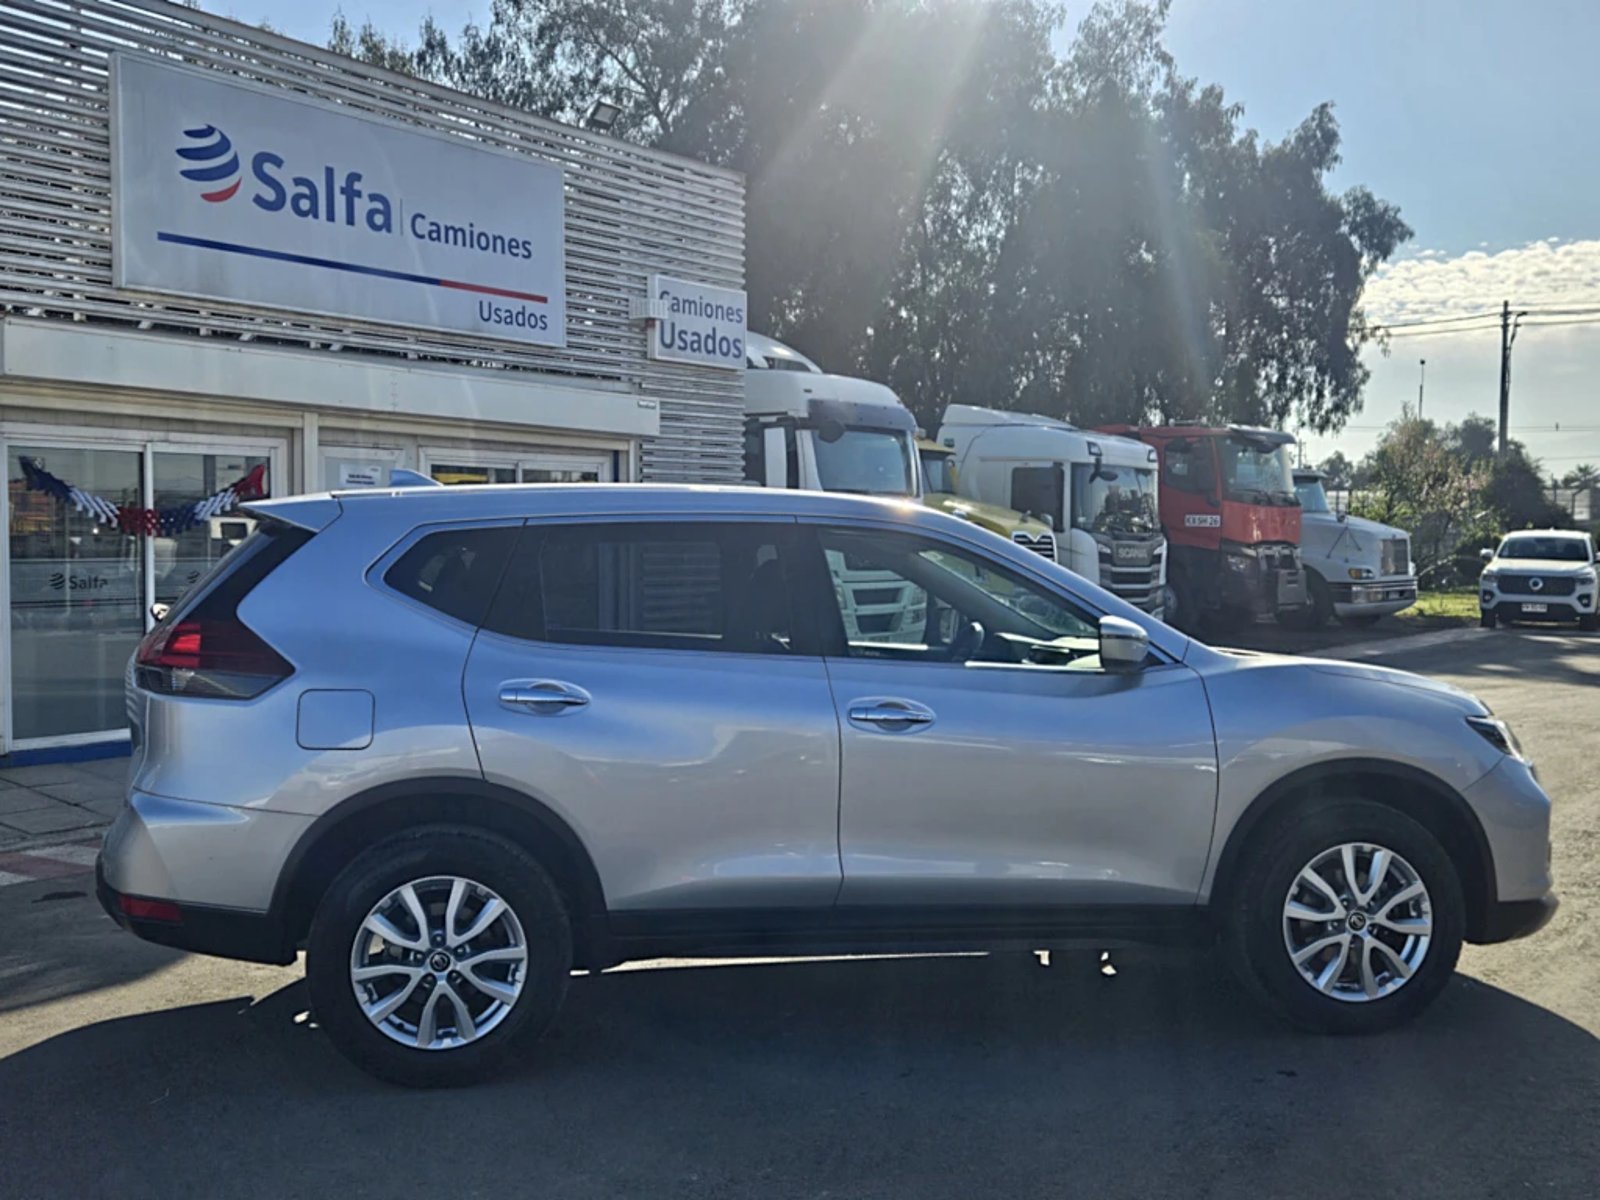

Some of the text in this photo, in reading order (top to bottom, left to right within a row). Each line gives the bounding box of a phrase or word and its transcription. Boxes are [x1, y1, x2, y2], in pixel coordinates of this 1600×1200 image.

[252, 151, 532, 259] Salfa Camiones
[479, 299, 548, 331] Usados
[660, 319, 742, 359] Usados
[69, 575, 108, 590] Salfa
